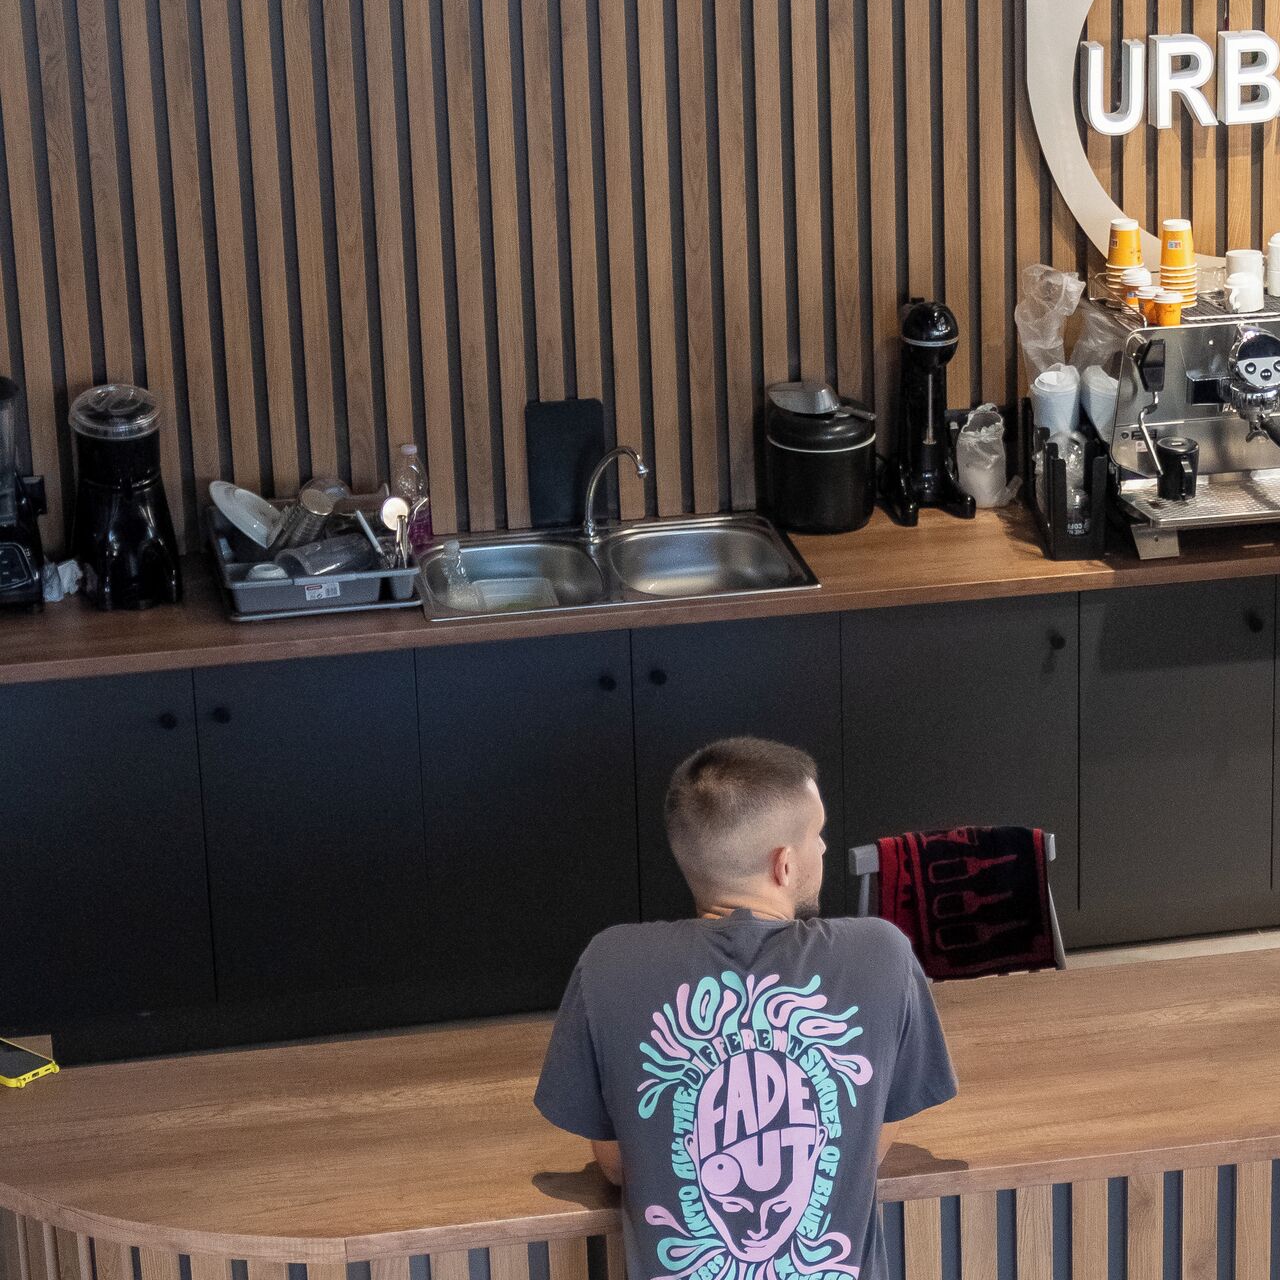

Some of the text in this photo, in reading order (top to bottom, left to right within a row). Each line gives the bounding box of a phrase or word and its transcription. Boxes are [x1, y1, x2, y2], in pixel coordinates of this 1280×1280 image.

[671, 1028, 842, 1240] INTO ALL THE DIFFERENT SHADES OF BLUE
[699, 1052, 816, 1156] FADE
[700, 1126, 816, 1196] OUT
